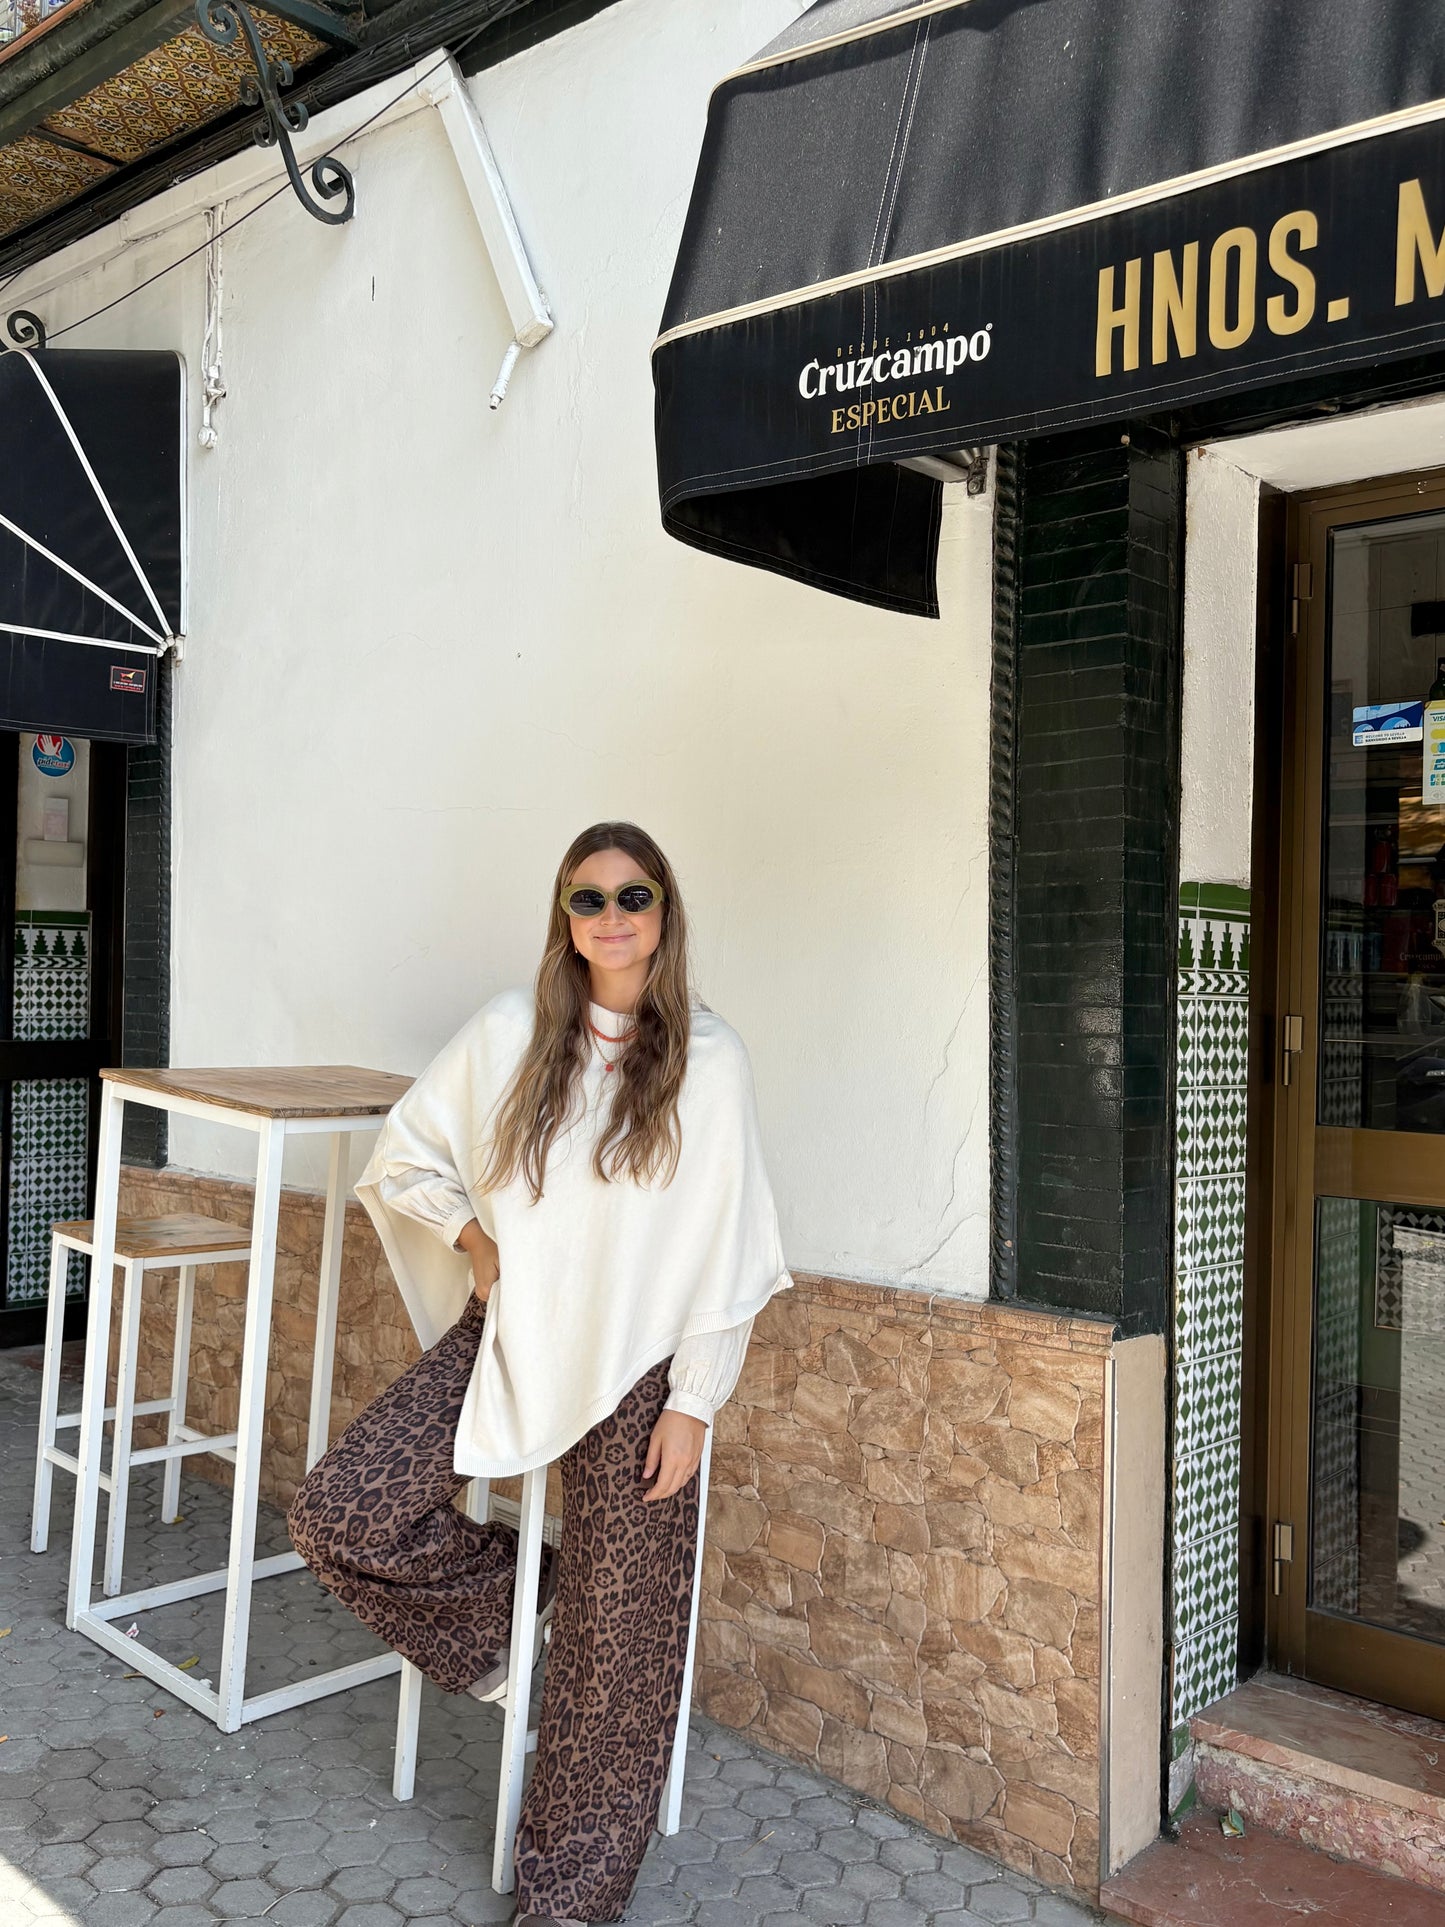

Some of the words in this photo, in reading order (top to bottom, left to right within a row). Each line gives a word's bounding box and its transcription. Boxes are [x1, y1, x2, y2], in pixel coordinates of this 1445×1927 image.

[1095, 210, 1349, 378] HNOS.
[798, 328, 991, 400] Cruzcampo
[837, 337, 890, 358] DESDE
[907, 322, 949, 342] 1904
[831, 385, 951, 434] ESPECIAL
